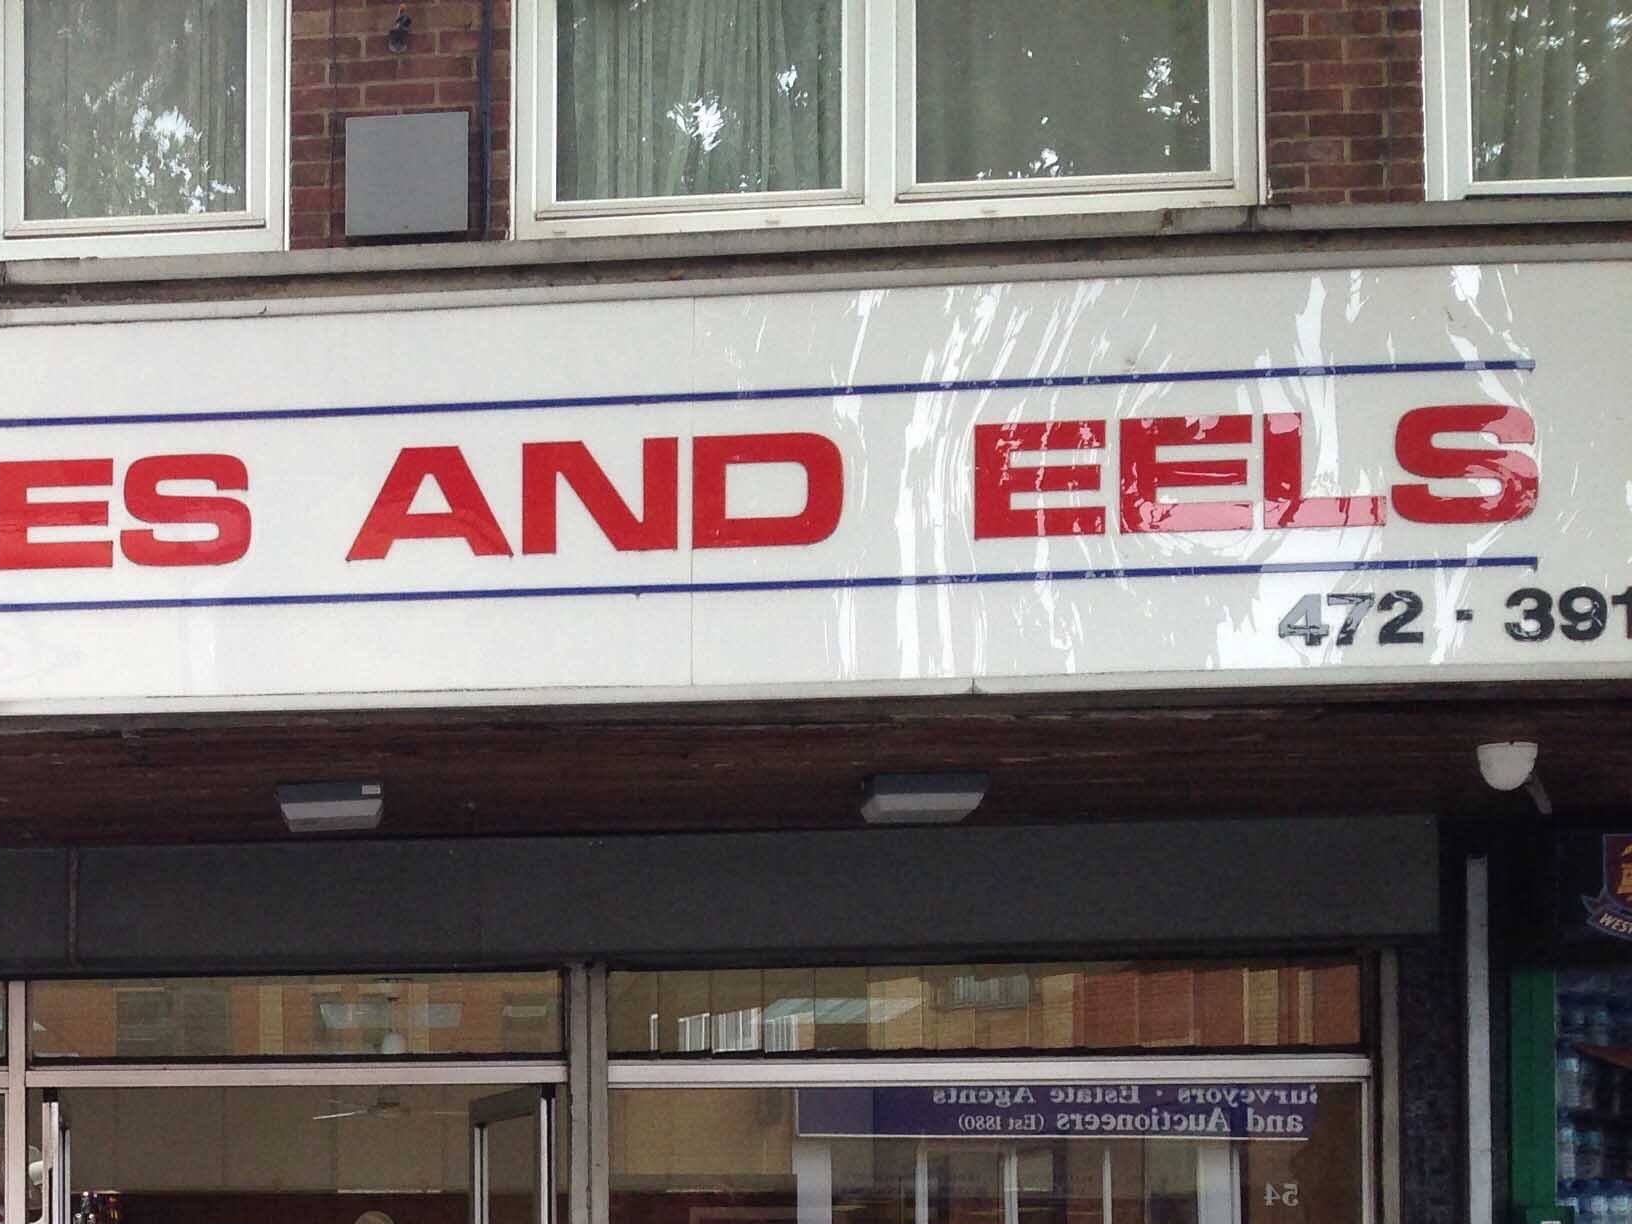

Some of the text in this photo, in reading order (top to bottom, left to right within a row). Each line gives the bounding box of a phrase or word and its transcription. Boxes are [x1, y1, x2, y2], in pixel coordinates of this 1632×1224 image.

[345, 431, 845, 562] AND
[973, 403, 1540, 541] EELS
[1277, 589, 1424, 648] 472
